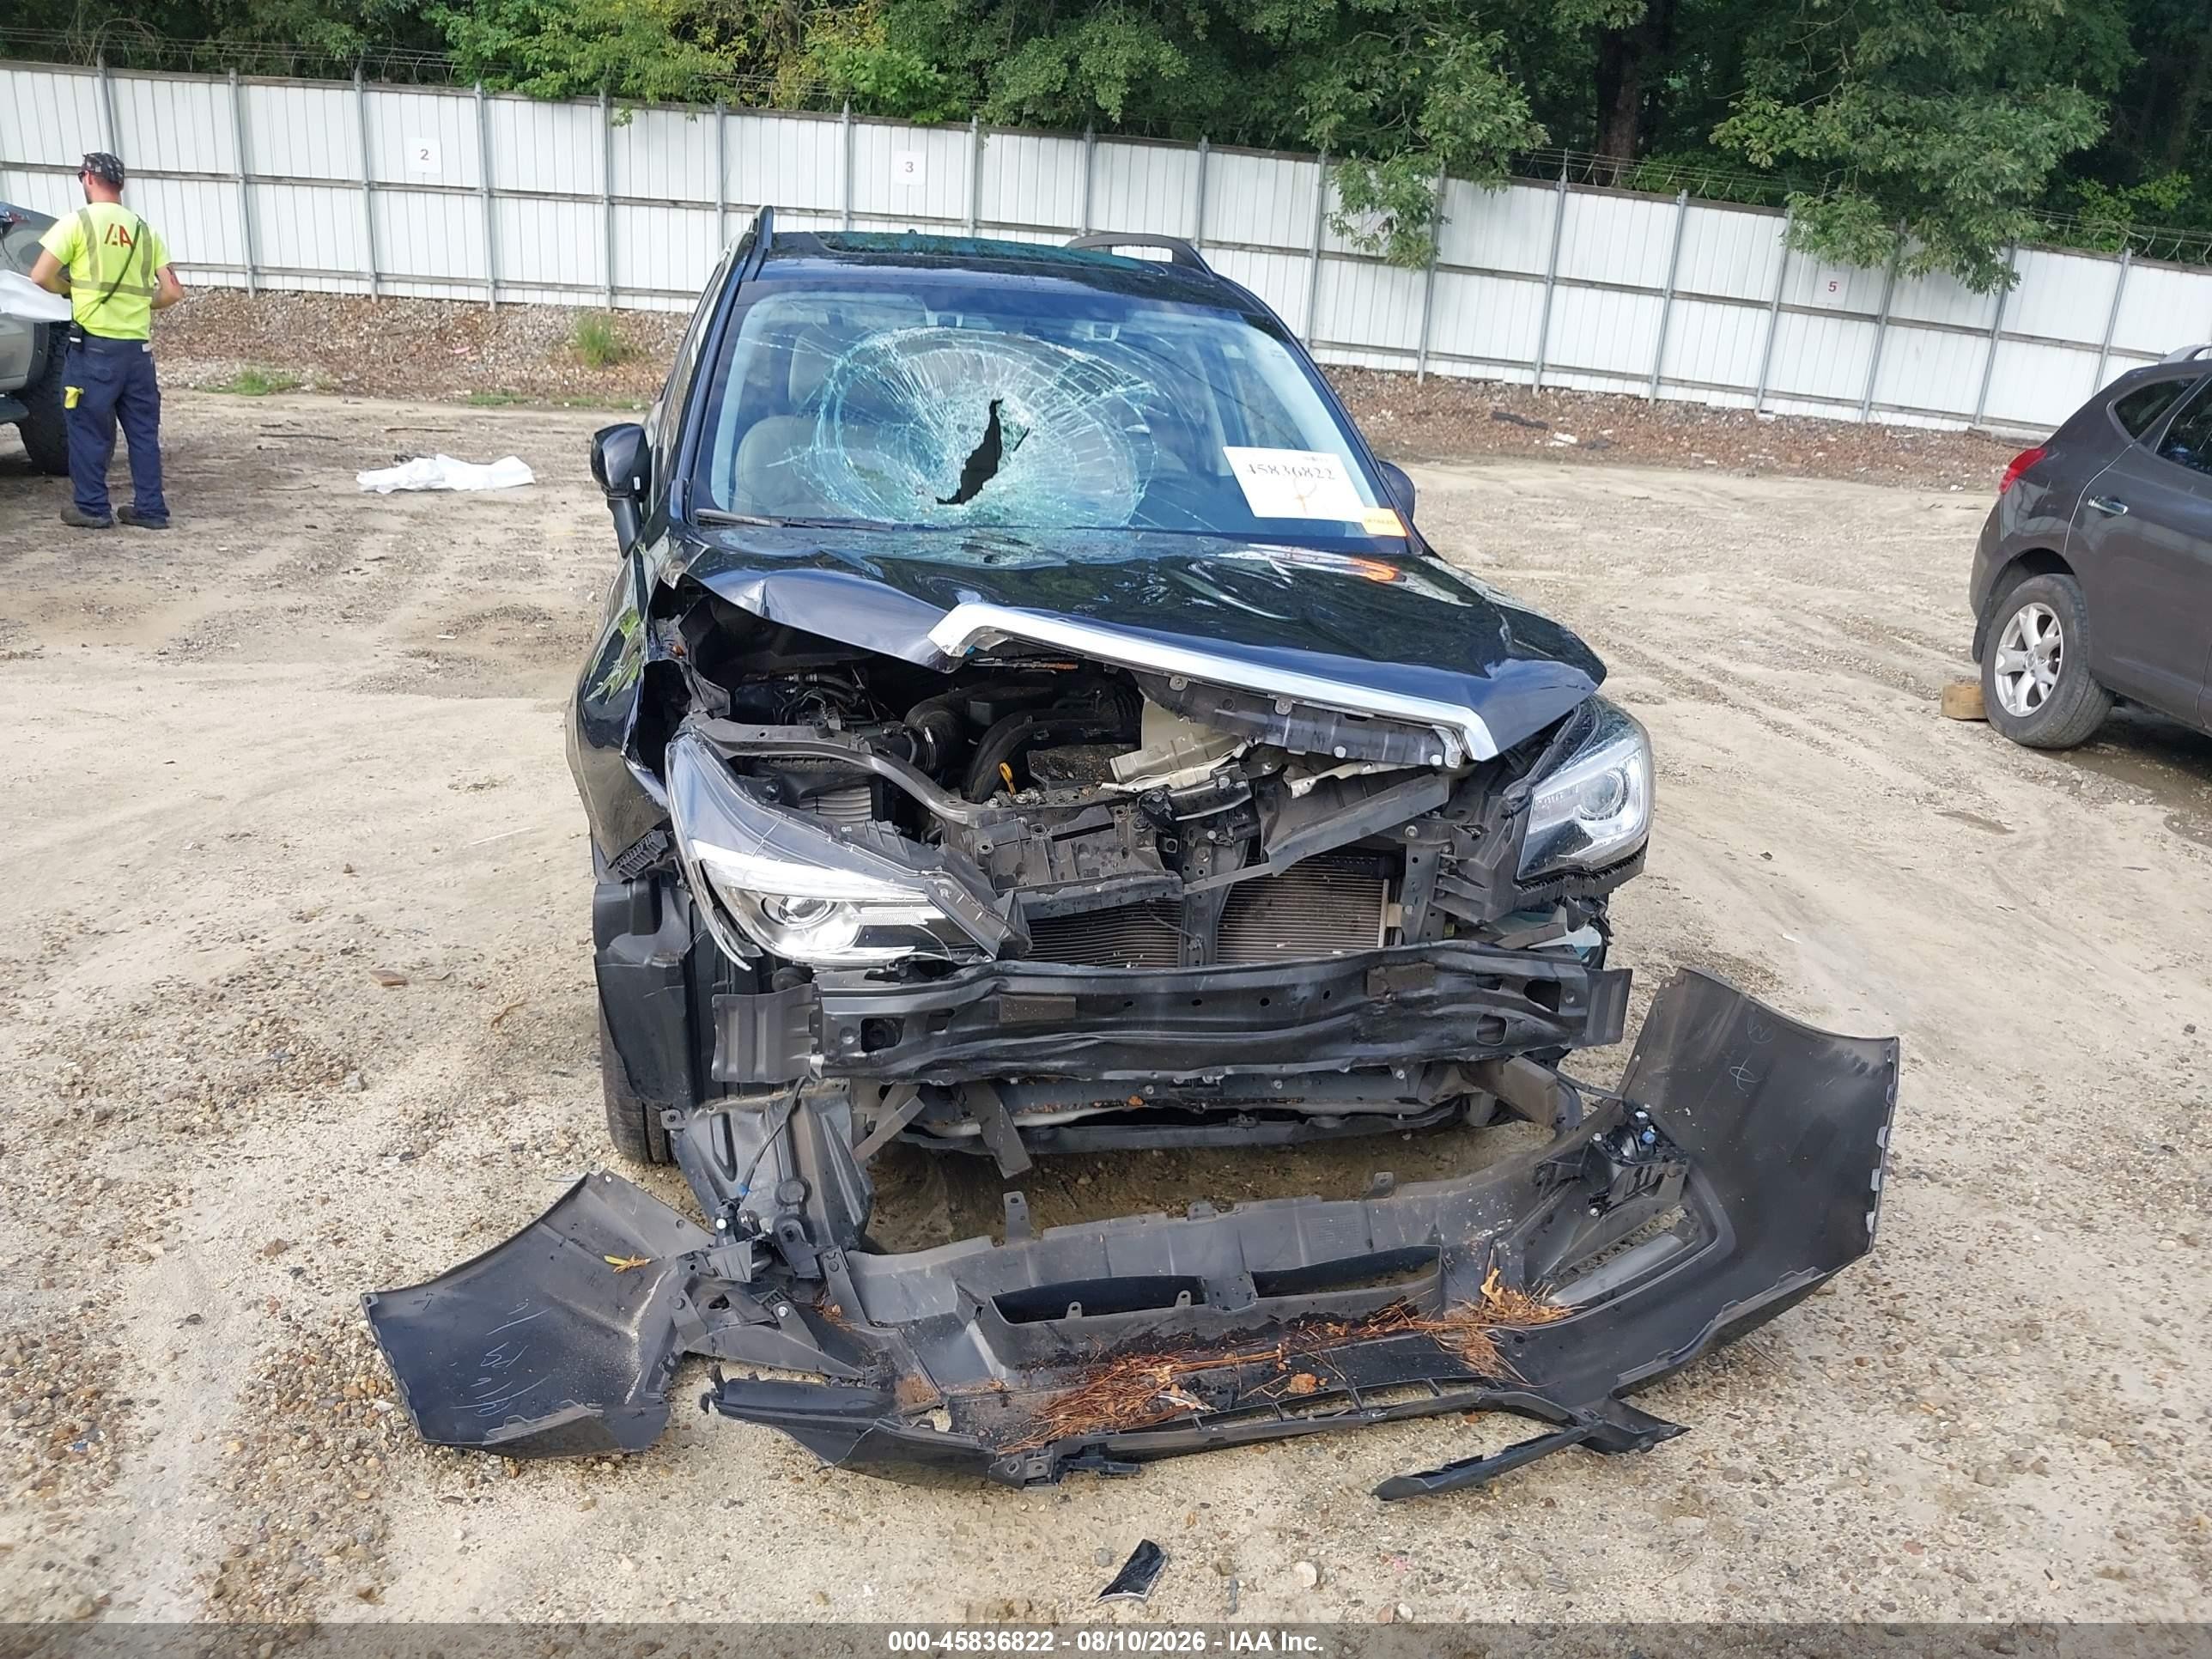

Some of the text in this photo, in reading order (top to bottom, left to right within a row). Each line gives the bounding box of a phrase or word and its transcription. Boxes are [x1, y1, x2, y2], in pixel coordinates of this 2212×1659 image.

[420, 149, 429, 161] 2
[905, 161, 914, 173] 3
[1828, 281, 1838, 292] 5
